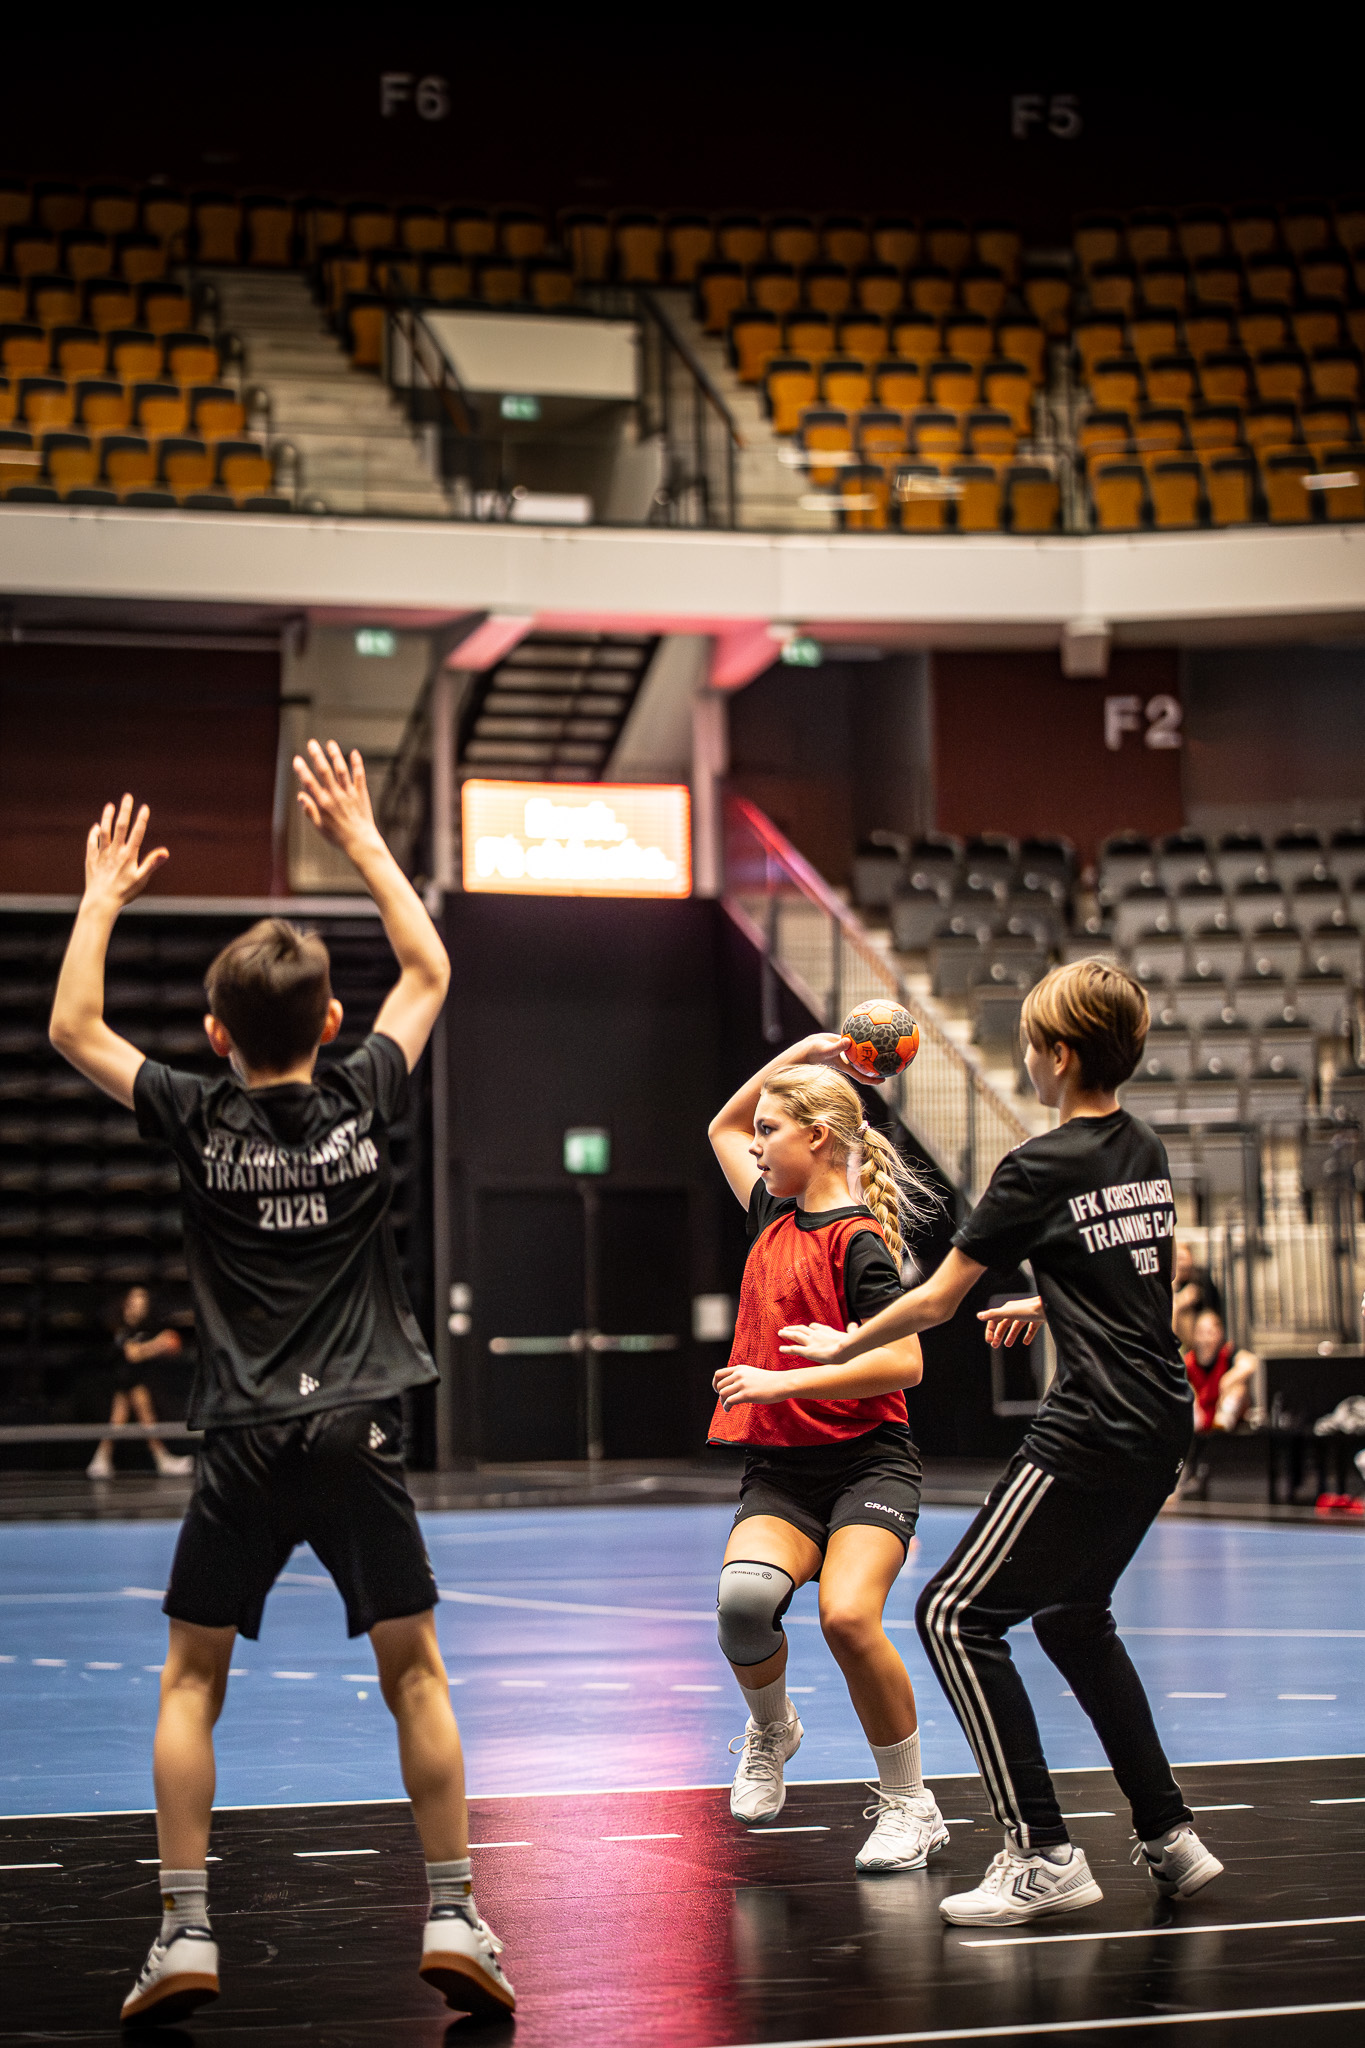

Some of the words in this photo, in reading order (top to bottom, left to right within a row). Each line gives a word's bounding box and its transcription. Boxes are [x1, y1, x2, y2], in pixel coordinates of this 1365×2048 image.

[380, 73, 449, 120] F6
[1011, 94, 1081, 139] F5
[1104, 695, 1182, 751] F2
[203, 1158, 318, 1192] TRAINING
[322, 1137, 379, 1186] CAMP
[258, 1192, 329, 1231] 2026
[1068, 1190, 1103, 1222] IFK
[1079, 1212, 1153, 1254] TRAINING
[864, 1501, 900, 1517] CRAFT
